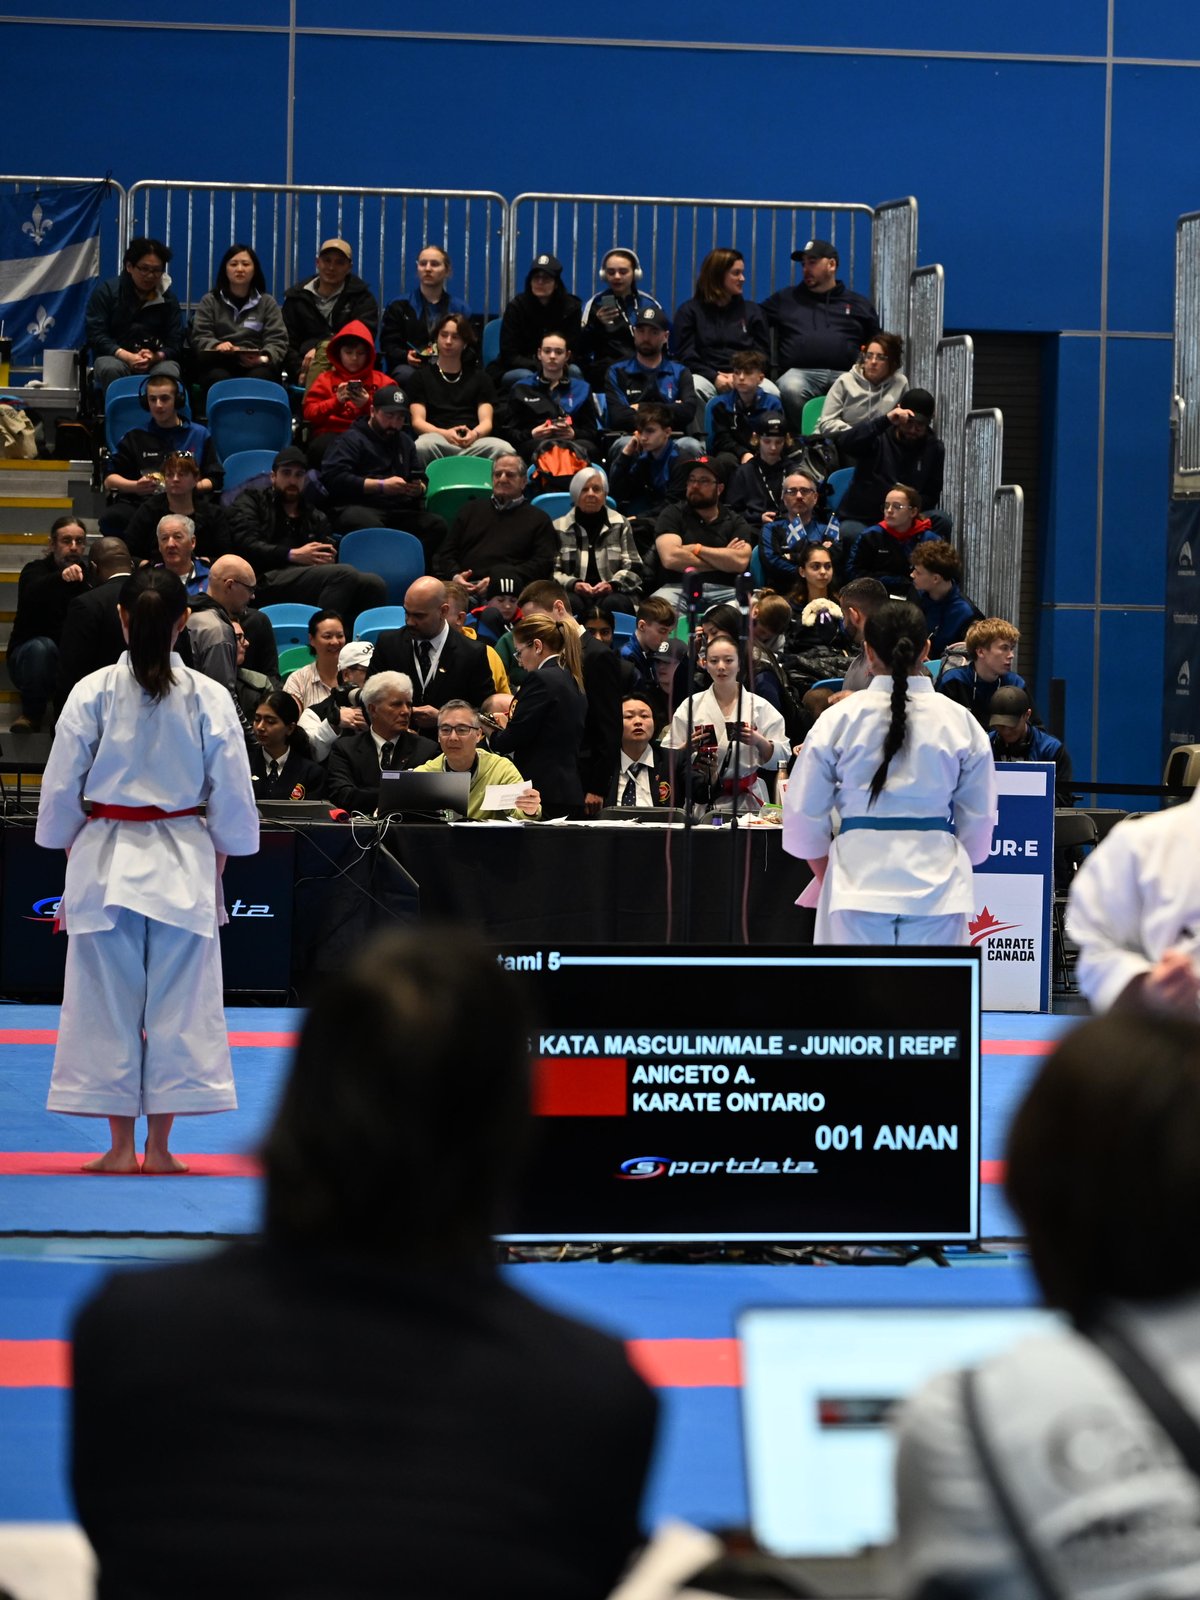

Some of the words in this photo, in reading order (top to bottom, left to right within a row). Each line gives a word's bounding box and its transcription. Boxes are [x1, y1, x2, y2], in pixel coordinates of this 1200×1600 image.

[988, 938, 1035, 949] KARATE
[496, 951, 543, 971] tami
[548, 951, 561, 971] 5
[988, 949, 1035, 962] CANADA
[539, 1035, 600, 1055] KATA
[604, 1035, 784, 1055] MASCULIN/MALE
[801, 1035, 883, 1056] JUNIOR
[899, 1036, 957, 1056] REPF
[632, 1064, 730, 1085] ANICETO
[734, 1064, 756, 1084] A.
[632, 1092, 721, 1112] KARATE
[726, 1092, 826, 1112] ONTARIO
[815, 1124, 863, 1151] 001
[873, 1124, 958, 1151] ANAN
